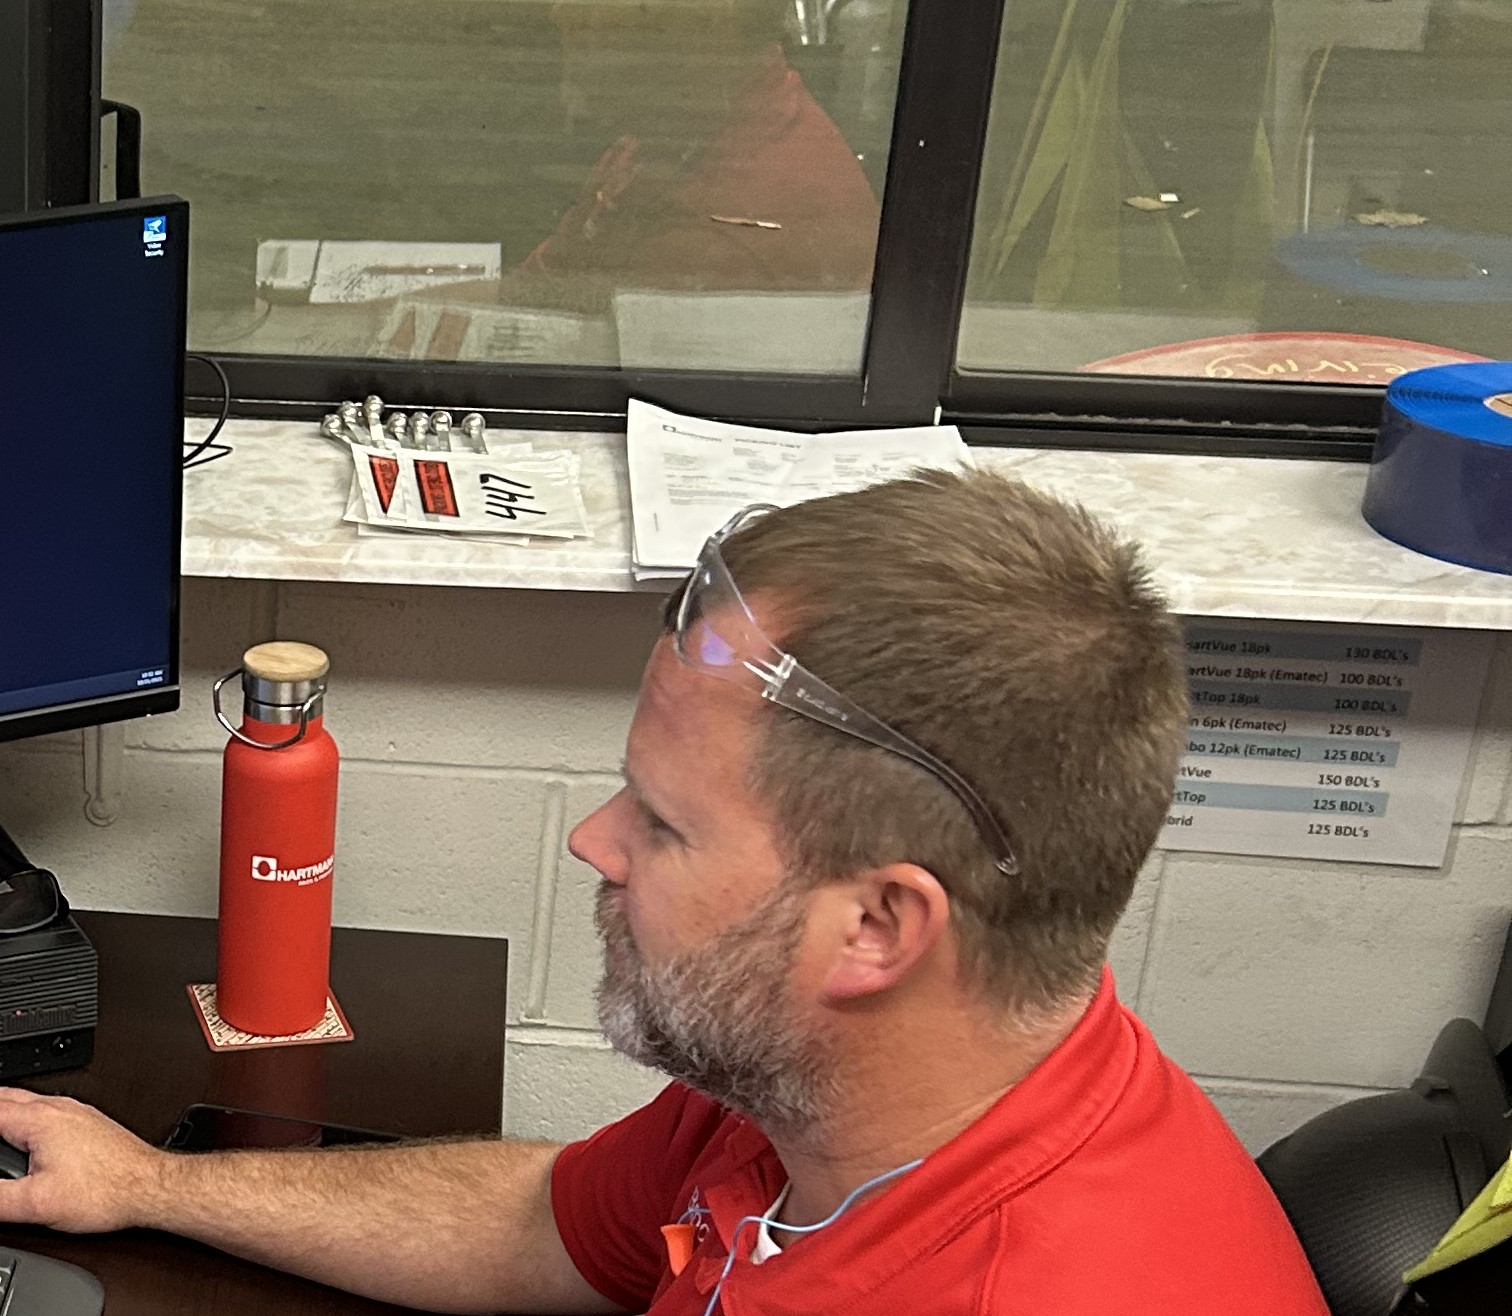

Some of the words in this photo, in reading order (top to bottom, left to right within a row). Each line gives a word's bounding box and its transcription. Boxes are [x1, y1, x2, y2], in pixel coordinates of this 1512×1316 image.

[1241, 641, 1272, 655] 18pk
[1188, 667, 1232, 678] artVue
[1235, 667, 1267, 681] 18pk
[1270, 669, 1329, 685] (Ematec)
[1340, 673, 1365, 686] 100
[1367, 674, 1403, 687] BDL's
[1202, 717, 1226, 730] 6pk
[1229, 717, 1288, 733] (Ematec)
[1327, 723, 1353, 736] 125
[1355, 725, 1392, 738] BDL's
[1186, 741, 1206, 752] bo
[1209, 742, 1240, 755] 12pk
[1243, 743, 1302, 760] (Ematec)
[1323, 749, 1347, 761] 125
[1350, 750, 1386, 763] BDL's
[1179, 766, 1212, 778] tVue
[1317, 774, 1342, 786] 150
[1345, 775, 1380, 788] BDL's
[1312, 799, 1336, 811] 125
[1339, 800, 1375, 813] BDL's
[1307, 823, 1331, 836] 125
[1334, 825, 1370, 838] BDL's
